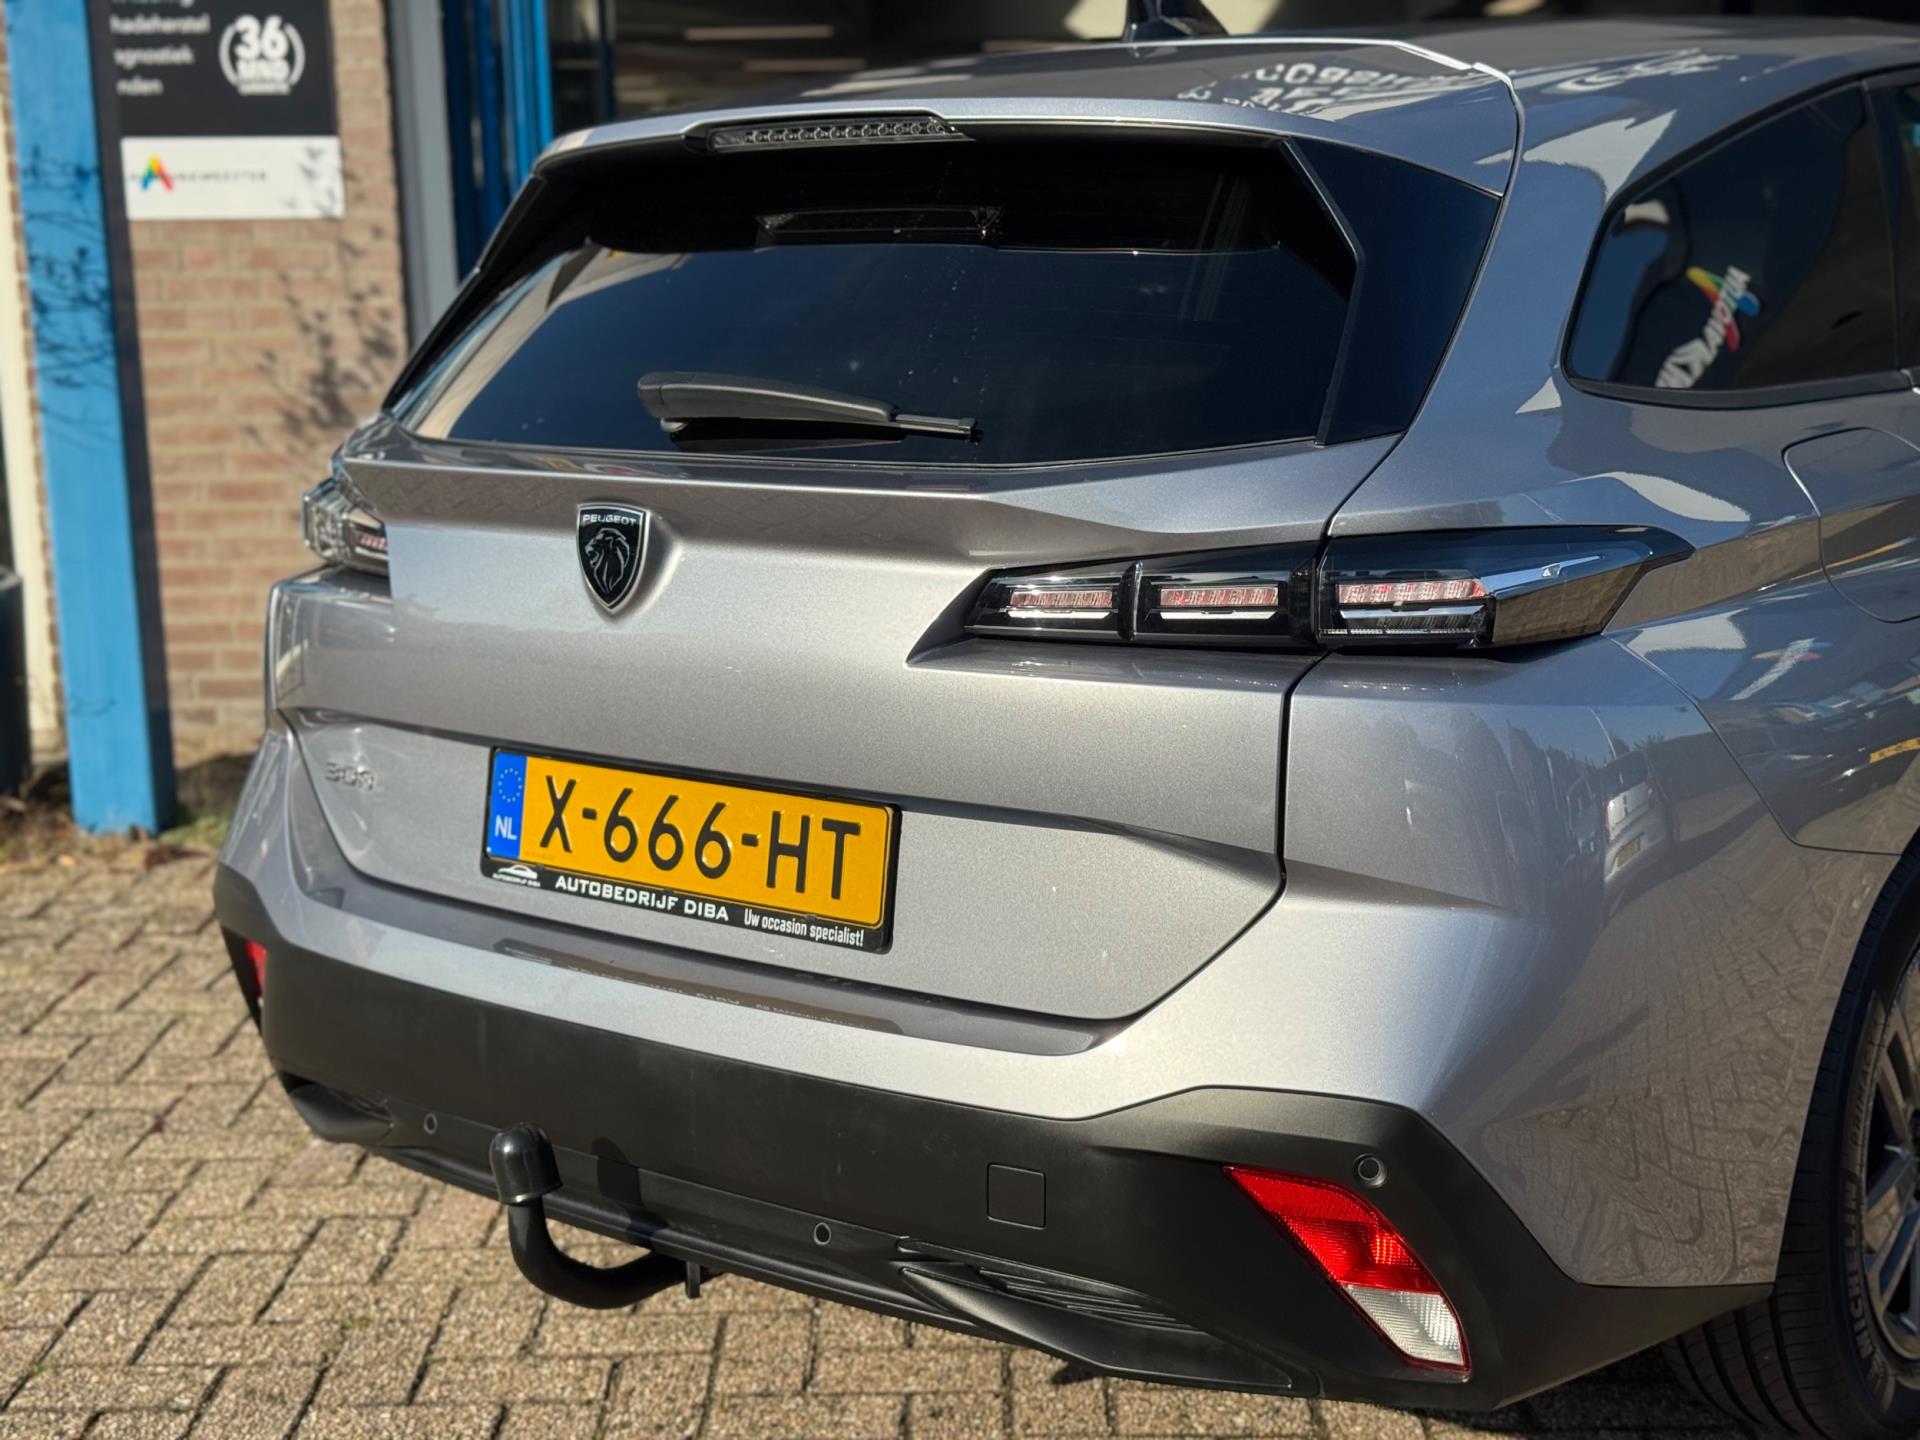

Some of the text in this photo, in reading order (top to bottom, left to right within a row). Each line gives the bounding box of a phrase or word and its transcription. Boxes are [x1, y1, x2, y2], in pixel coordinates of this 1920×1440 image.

[234, 15, 289, 59] 36
[583, 514, 636, 526] PEUGEOT
[494, 815, 517, 841] NL
[539, 775, 862, 900] X-666-HT
[555, 875, 729, 922] AUTOBEDRIJF DIBA
[744, 908, 864, 947] Uw occasion specialist!
[1844, 1181, 1873, 1359] MICHELIN
